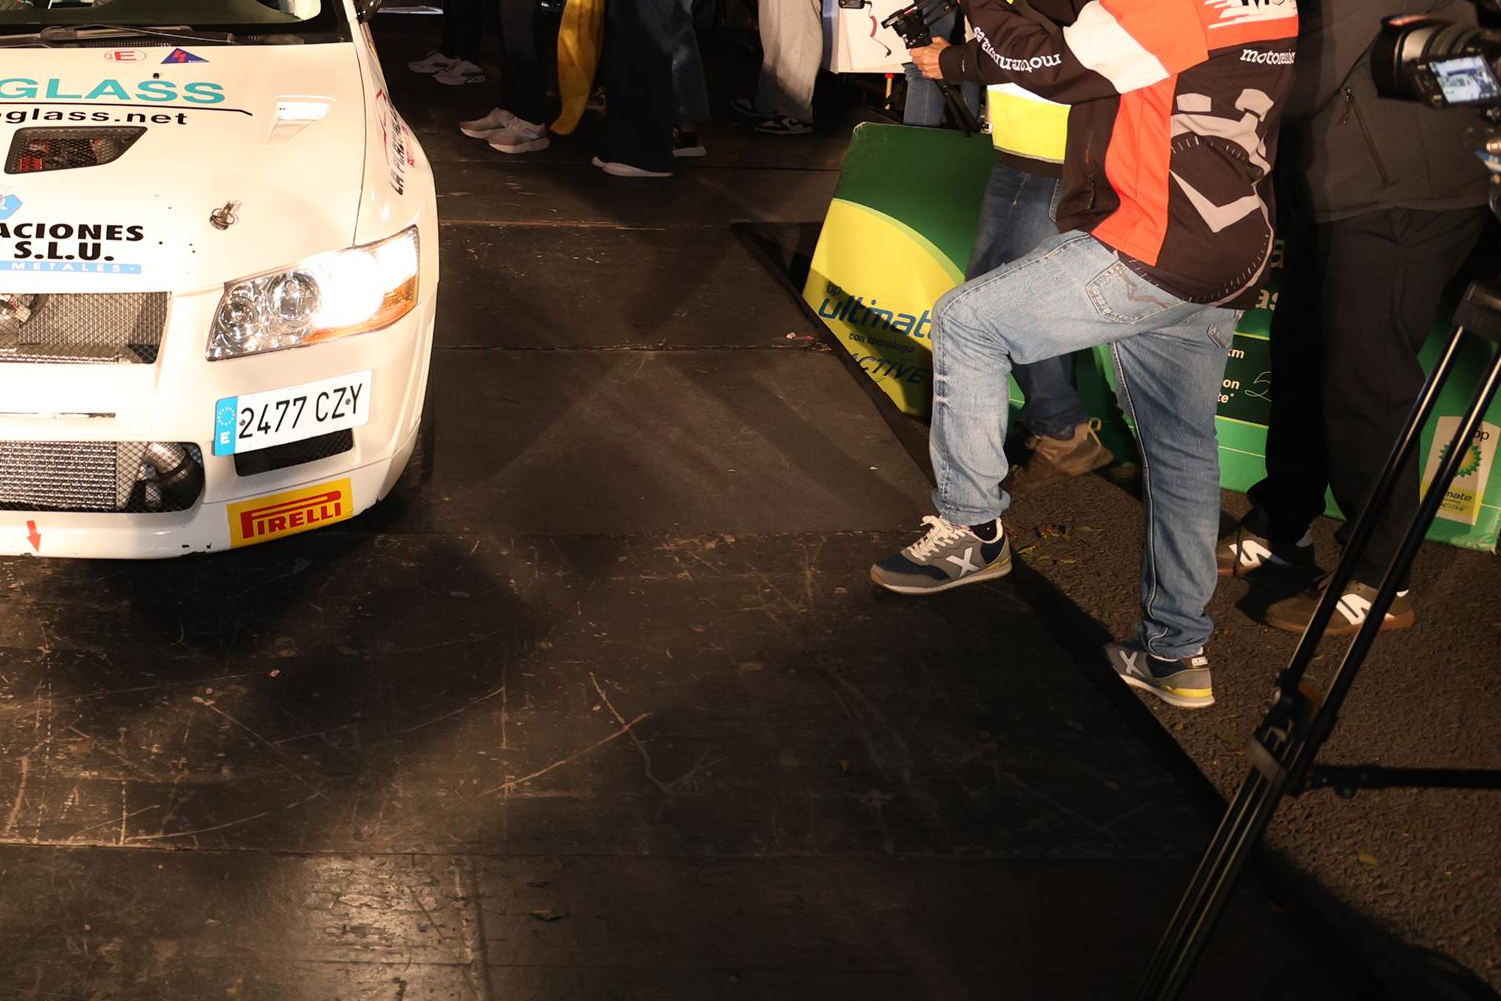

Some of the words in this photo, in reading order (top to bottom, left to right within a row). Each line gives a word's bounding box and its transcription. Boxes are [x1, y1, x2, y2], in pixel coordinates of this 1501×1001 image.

[14, 241, 114, 262] S.L.U.
[11, 261, 122, 274] METALES
[818, 295, 933, 339] ultimat
[848, 332, 865, 343] con
[238, 396, 307, 440] 2477
[315, 383, 363, 423] CZY
[220, 431, 230, 445] E
[240, 490, 342, 540] PIRELLI
